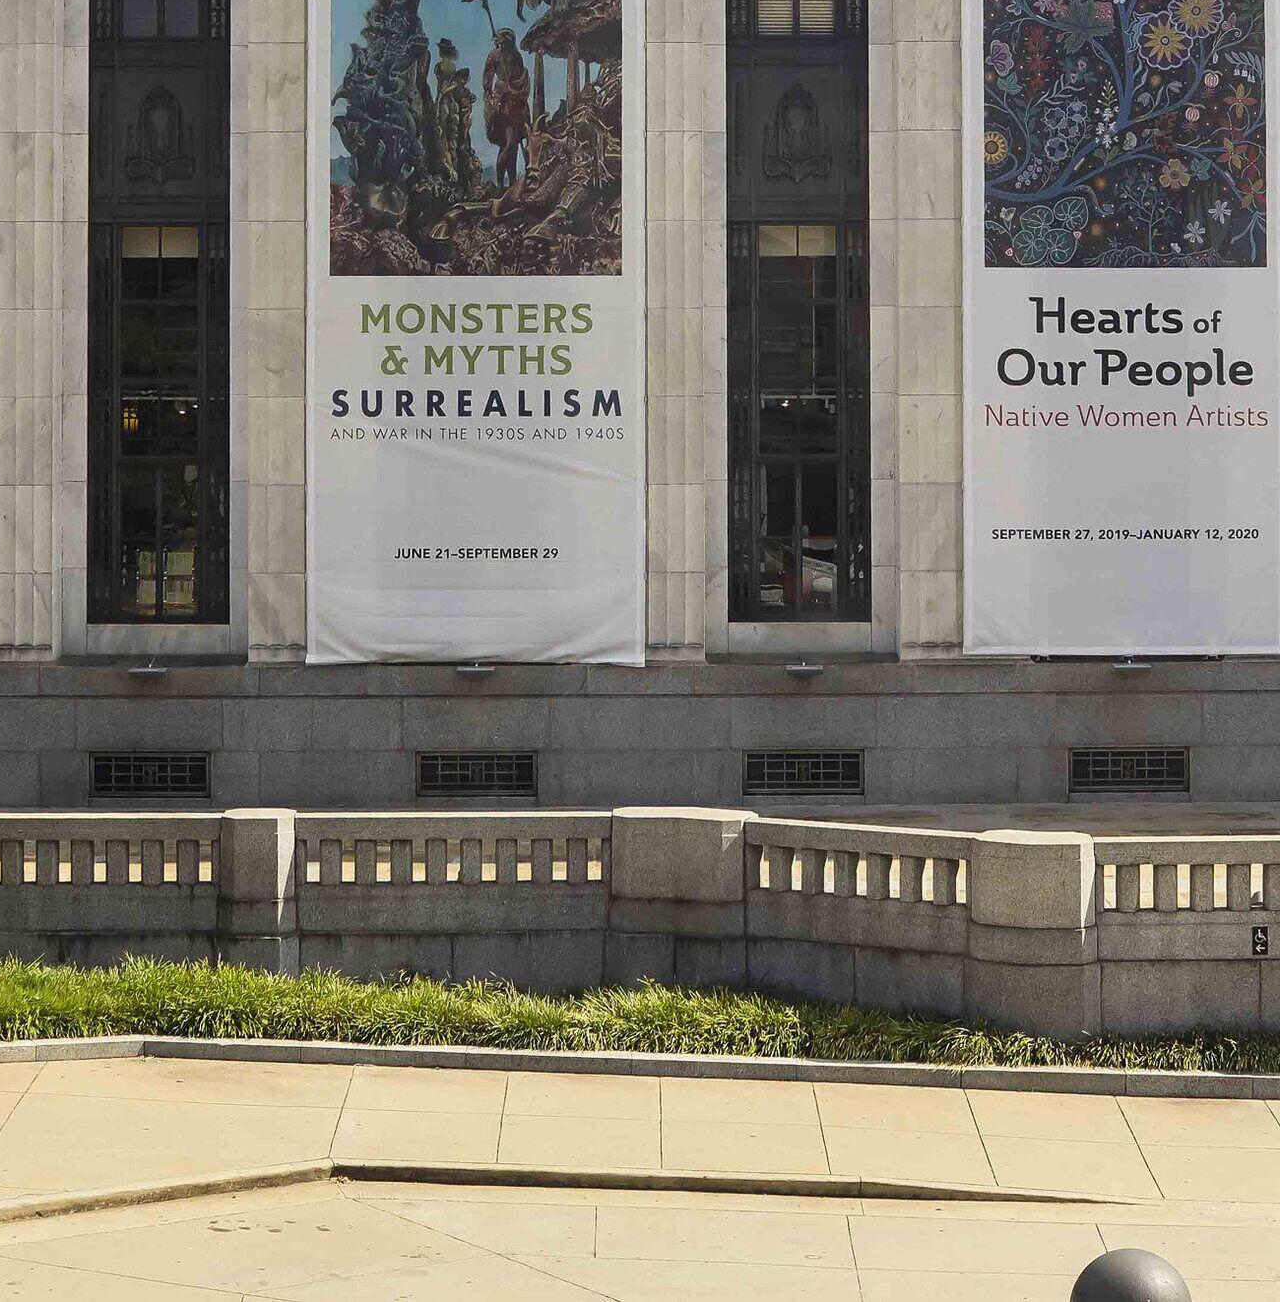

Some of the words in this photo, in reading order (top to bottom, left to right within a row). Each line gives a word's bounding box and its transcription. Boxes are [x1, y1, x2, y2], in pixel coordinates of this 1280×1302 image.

[360, 302, 594, 334] MONSTERS
[1029, 296, 1183, 334] Hearts
[1193, 309, 1223, 334] of
[380, 345, 408, 376] &
[424, 345, 574, 376] MYTHS
[996, 347, 1087, 386] Our
[1093, 347, 1254, 397] People
[330, 388, 623, 418] SURREALISM
[985, 403, 1069, 428] Native
[1076, 403, 1177, 428] Women
[1186, 403, 1269, 428] Artists
[330, 427, 366, 441] AND
[373, 427, 408, 441] WAR
[415, 427, 433, 441] IN
[440, 427, 468, 441] THE
[476, 427, 525, 441] 1930S
[532, 427, 568, 441] AND
[576, 427, 625, 441] 1940S
[991, 528, 1071, 541] SEPTEMBER
[1075, 528, 1094, 542] 27,
[1204, 528, 1224, 541] 12,
[1227, 527, 1260, 540] 2020
[394, 547, 431, 560] JUNE
[543, 547, 559, 559] 29
